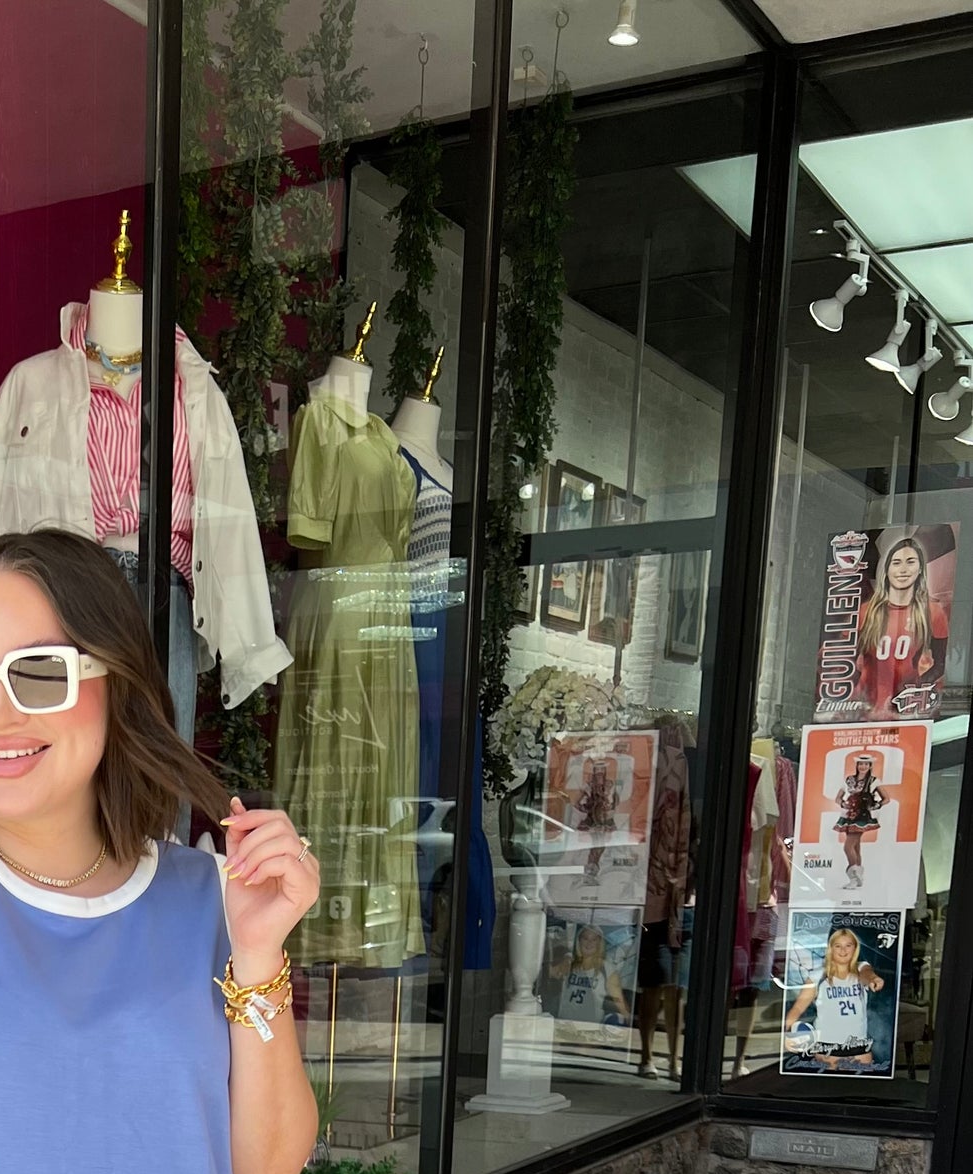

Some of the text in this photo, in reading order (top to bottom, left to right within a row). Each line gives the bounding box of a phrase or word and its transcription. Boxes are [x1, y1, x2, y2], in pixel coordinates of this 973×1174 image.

[819, 573, 863, 702] GUILLEN
[876, 635, 911, 661] 00
[833, 734, 899, 746] SOUTHERN STARS
[804, 858, 833, 868] ROMAN
[794, 914, 900, 933] LADY COUGARS
[839, 1000, 856, 1016] 24
[792, 1144, 832, 1155] MAIL
